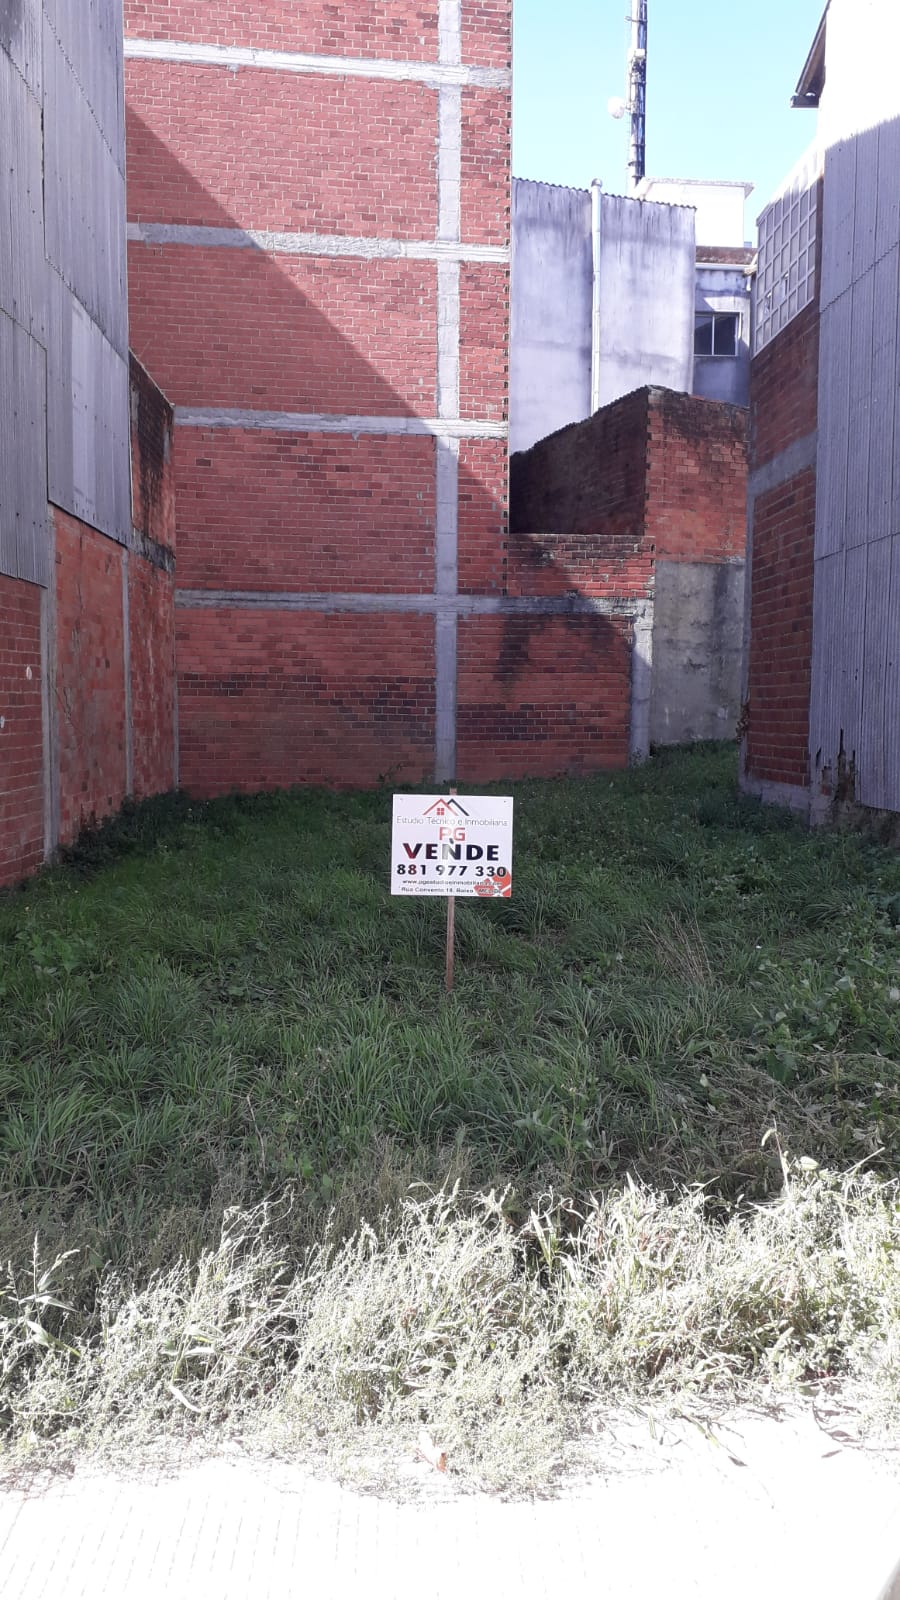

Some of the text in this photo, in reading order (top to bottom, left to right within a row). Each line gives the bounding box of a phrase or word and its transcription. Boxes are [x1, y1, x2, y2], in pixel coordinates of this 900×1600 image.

[396, 816, 424, 824] Estudio
[464, 818, 507, 826] Inmobiliaria
[439, 827, 465, 841] PG
[402, 843, 499, 861] VENDE
[396, 864, 507, 877] 881 977 330
